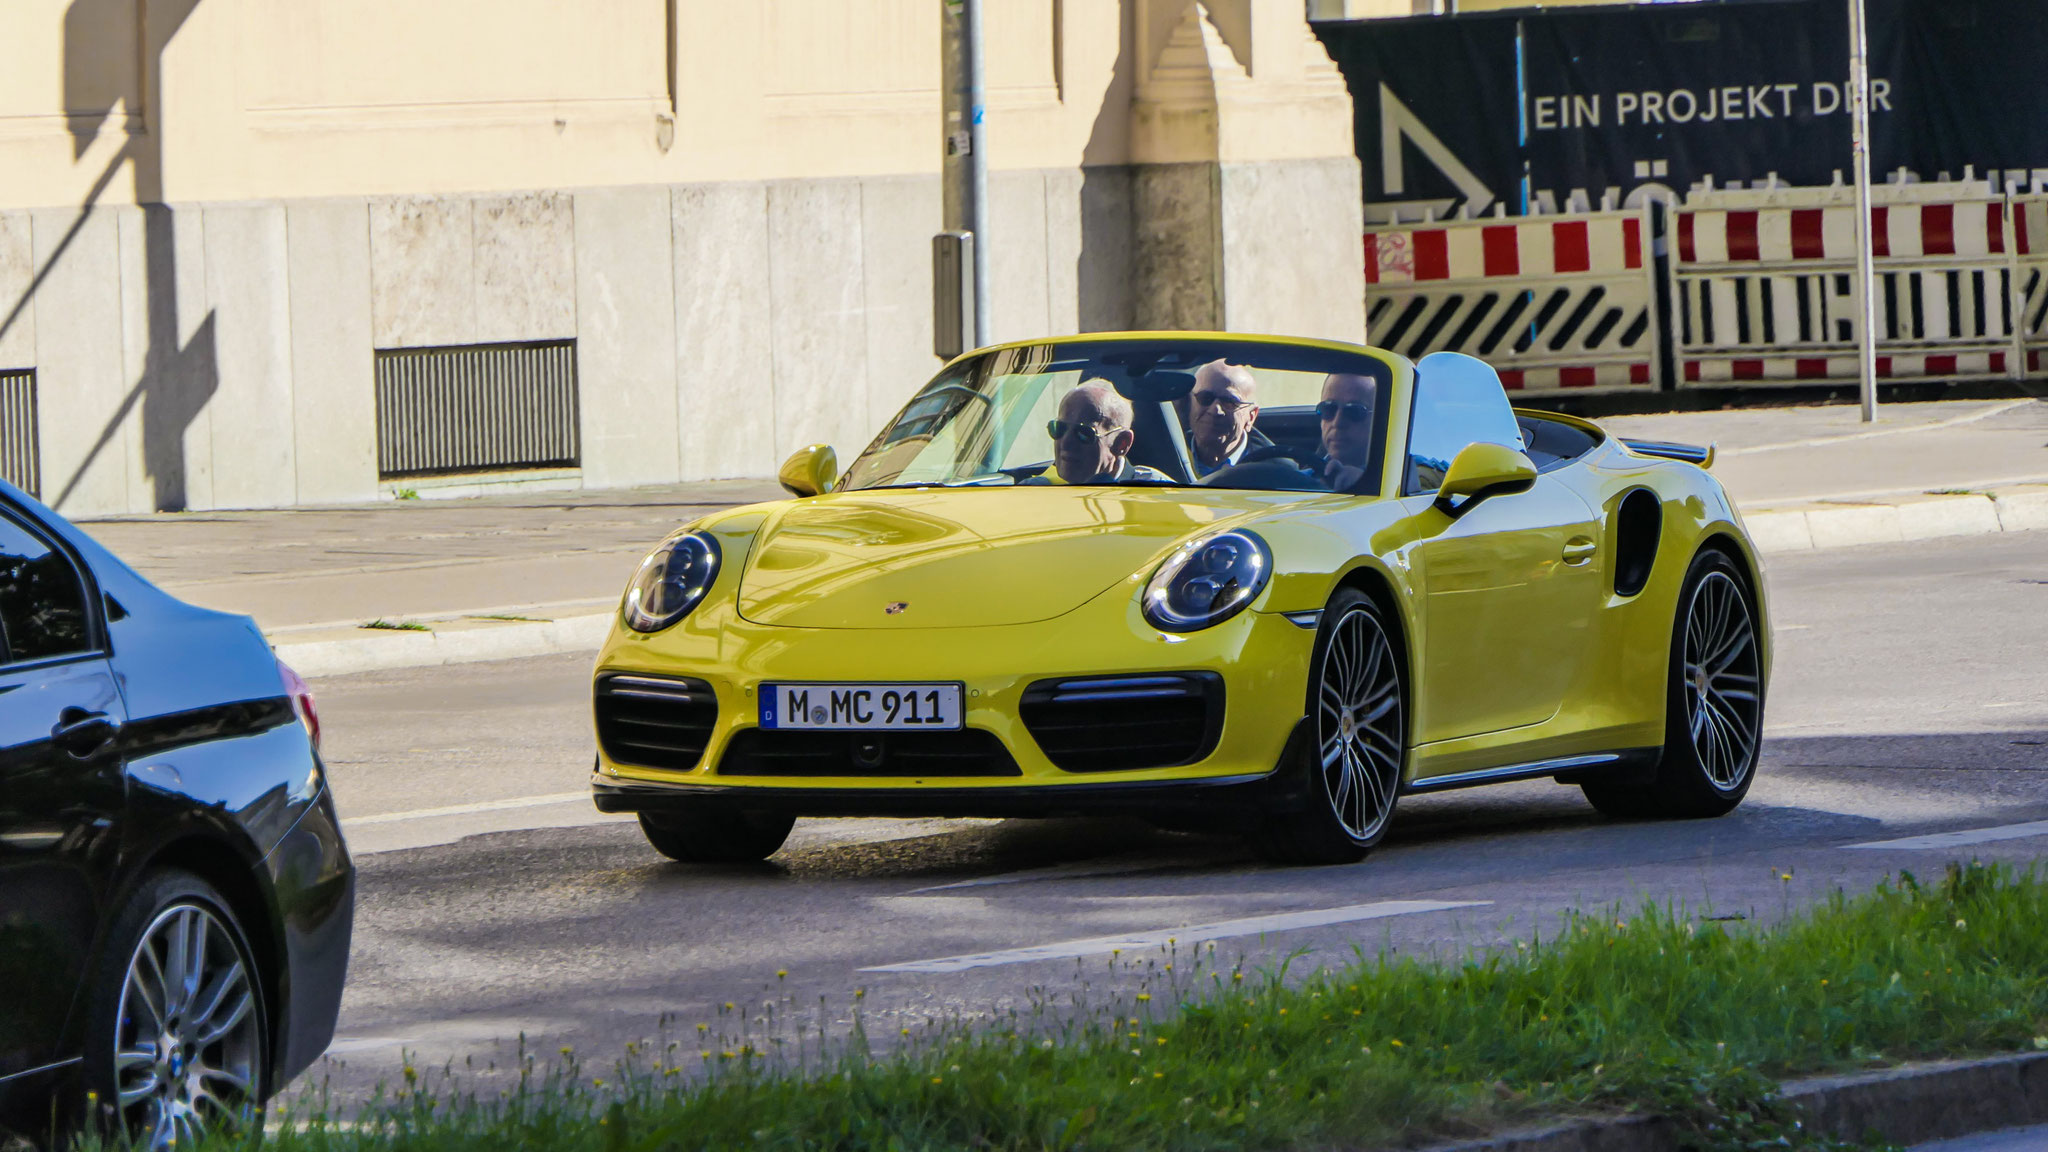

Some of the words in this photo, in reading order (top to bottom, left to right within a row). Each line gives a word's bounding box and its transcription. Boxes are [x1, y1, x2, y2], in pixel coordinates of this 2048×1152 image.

[1535, 94, 1600, 130] EIN
[1617, 83, 1798, 126] PROJEKT
[765, 711, 772, 721] D
[788, 689, 809, 723] M
[830, 690, 874, 724] MC
[881, 690, 945, 724] 911
